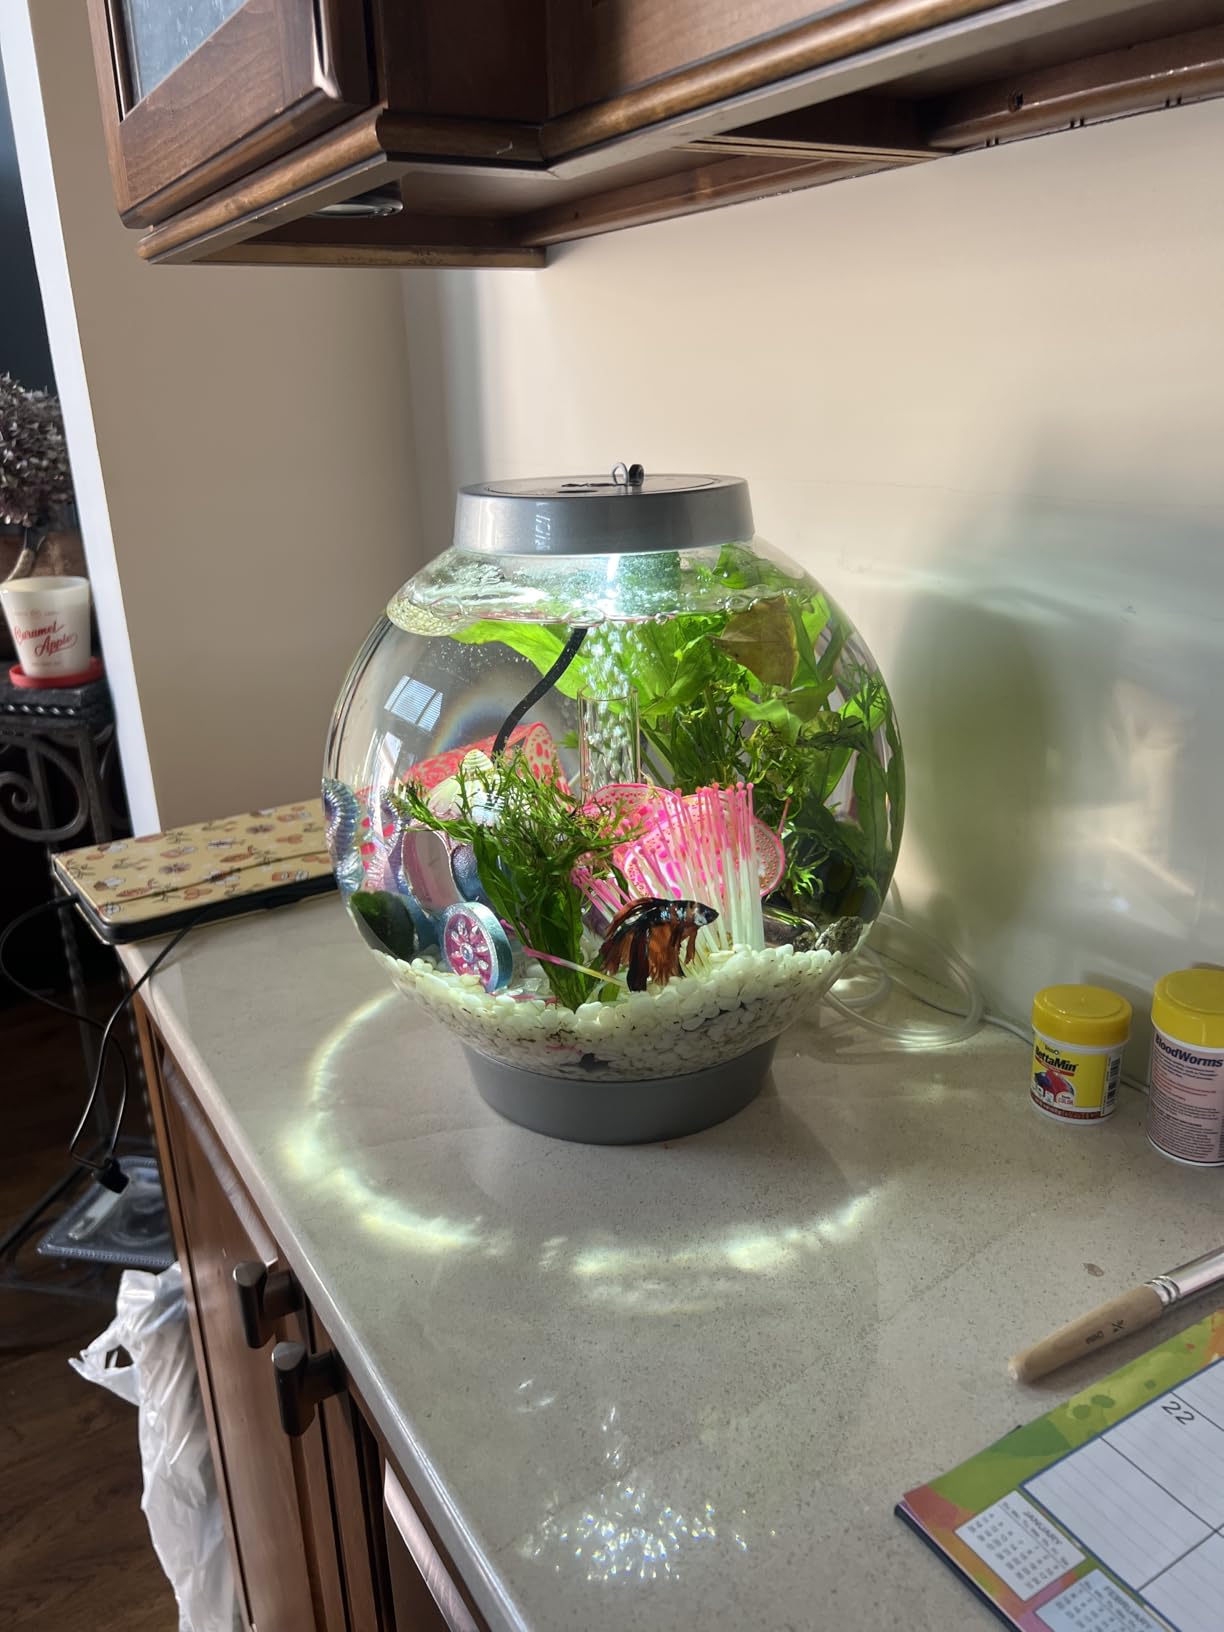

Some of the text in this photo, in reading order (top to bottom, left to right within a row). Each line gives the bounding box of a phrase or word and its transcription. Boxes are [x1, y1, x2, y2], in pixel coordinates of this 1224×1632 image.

[15, 621, 64, 644] Caramel
[35, 634, 78, 656] Apple
[1035, 1045, 1076, 1072] BettaMin
[1155, 1033, 1224, 1067] BloodWorms
[1161, 1401, 1195, 1425] 22
[1023, 1511, 1062, 1545] JANUARY
